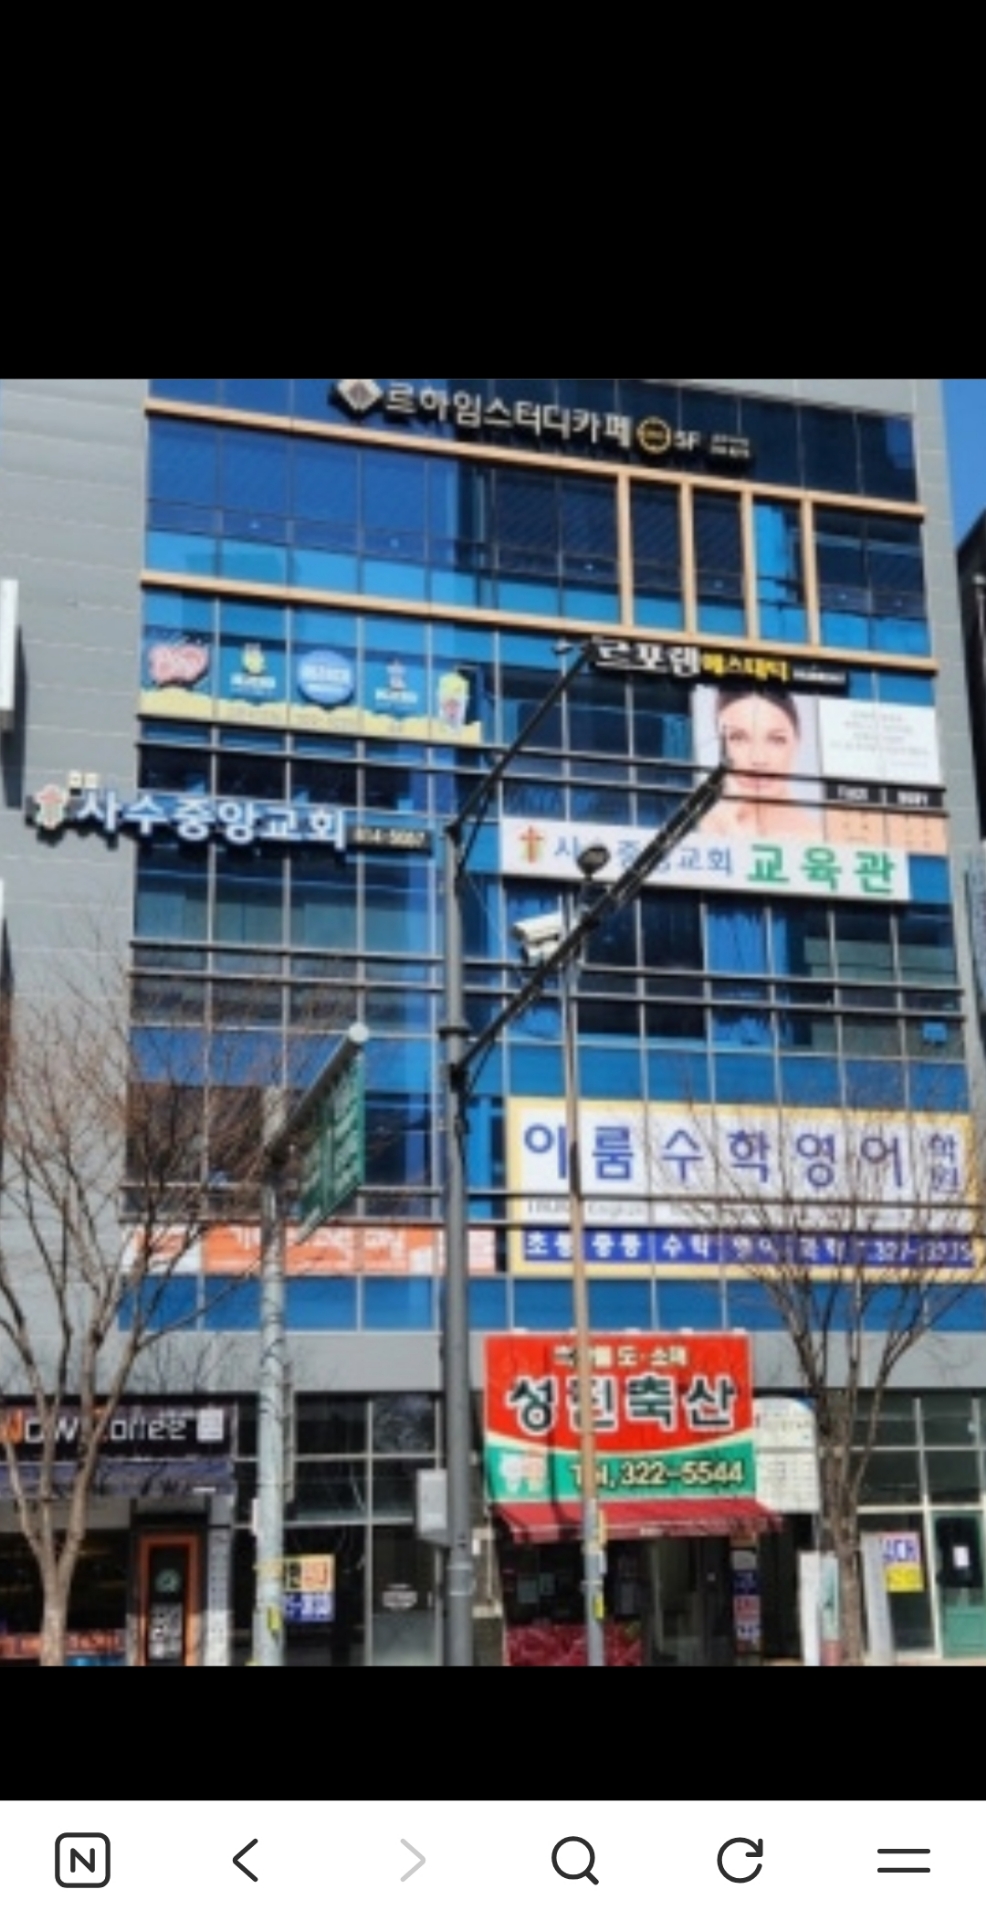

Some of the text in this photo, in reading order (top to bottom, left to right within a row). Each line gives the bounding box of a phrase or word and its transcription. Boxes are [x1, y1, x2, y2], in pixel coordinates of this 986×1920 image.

[386, 381, 632, 448] 르하임스터디카페
[76, 789, 345, 851] 사수중앙교회
[553, 834, 895, 893] 사중교회 교육관
[619, 1460, 743, 1486] 322-5544
